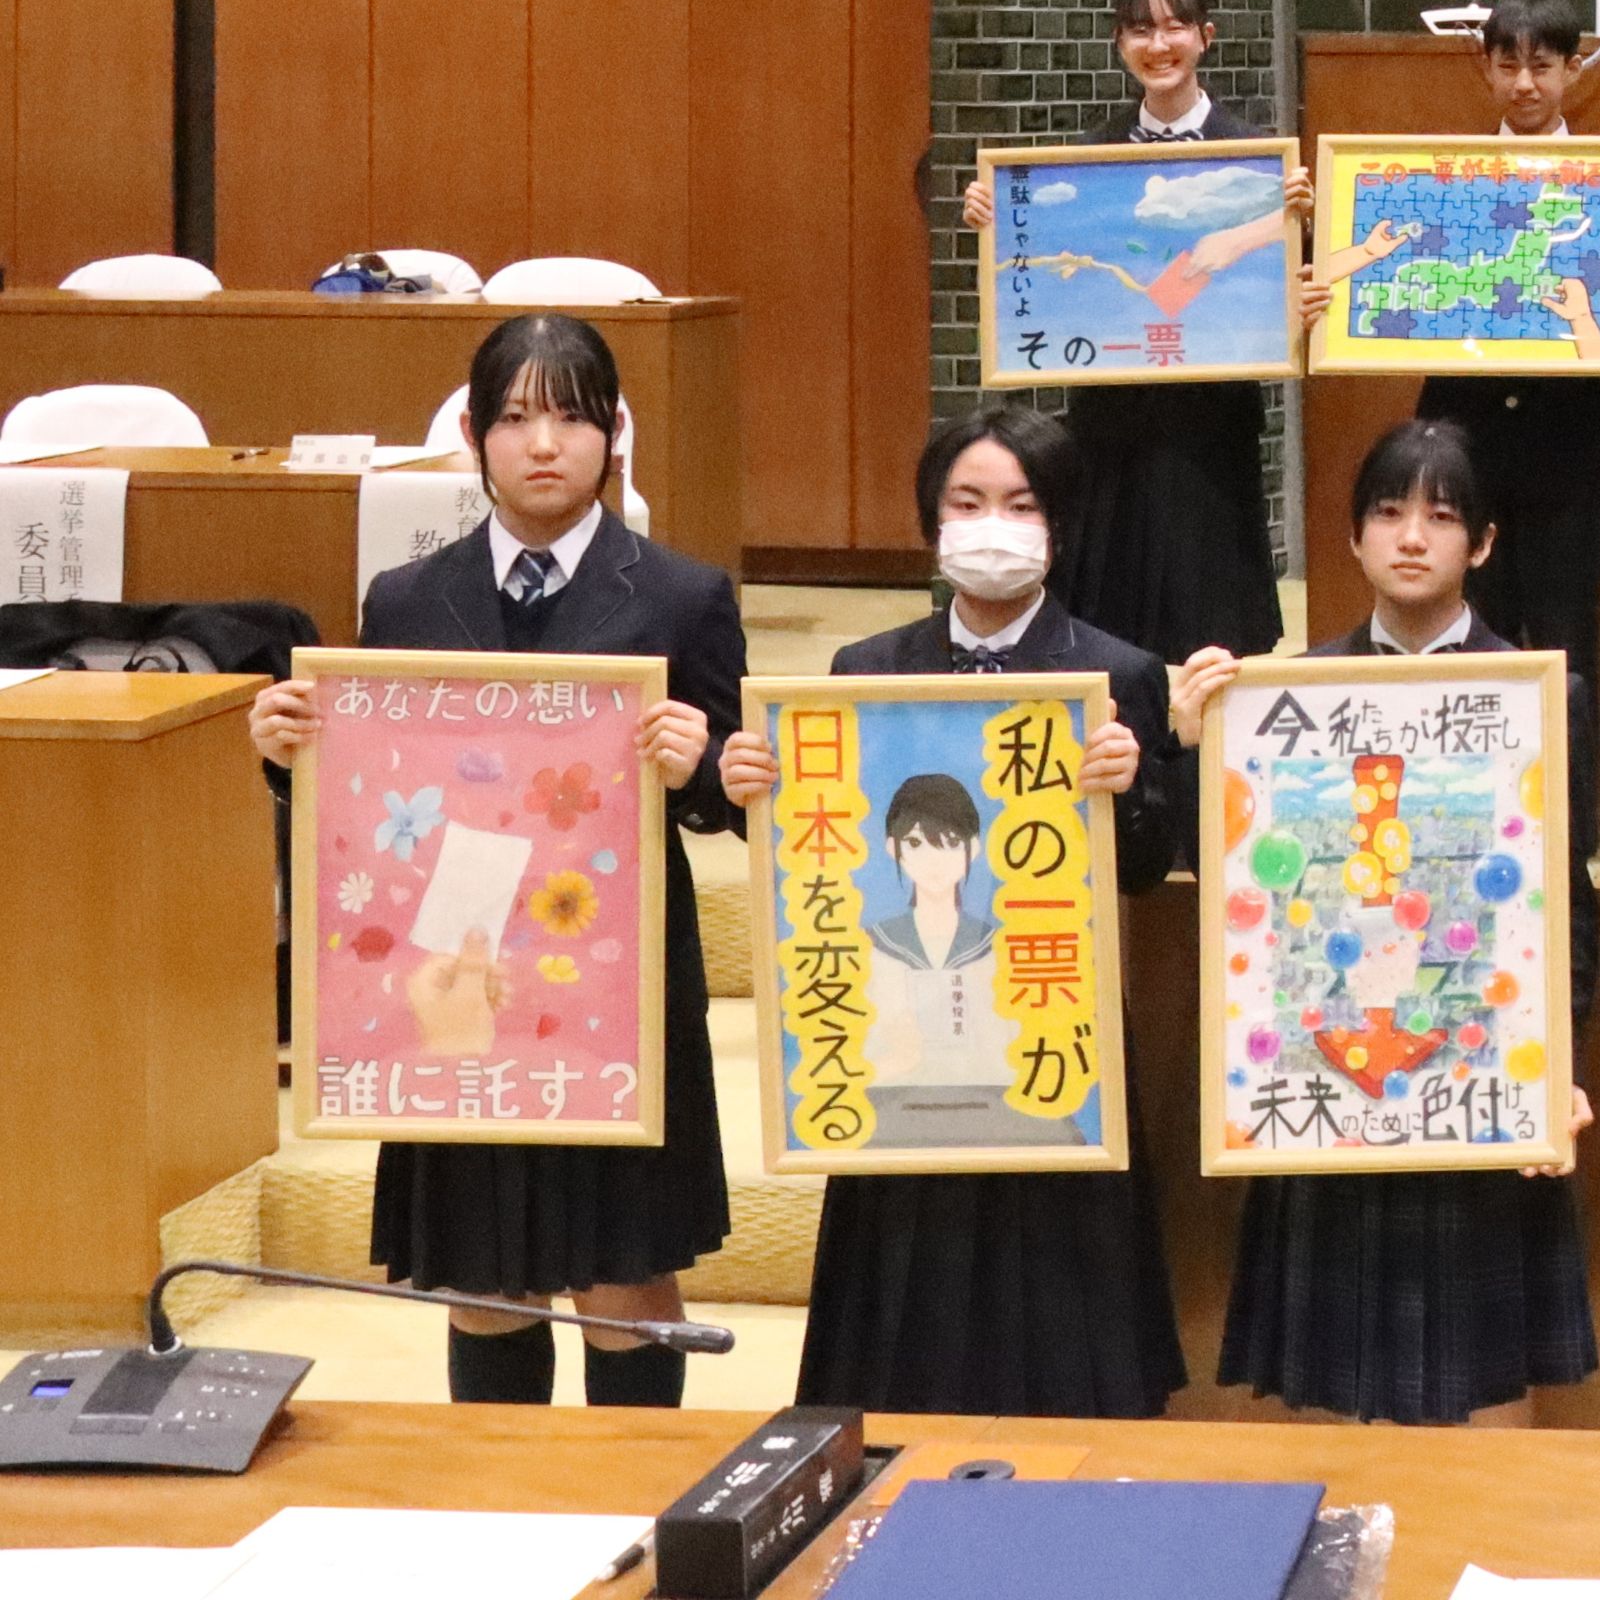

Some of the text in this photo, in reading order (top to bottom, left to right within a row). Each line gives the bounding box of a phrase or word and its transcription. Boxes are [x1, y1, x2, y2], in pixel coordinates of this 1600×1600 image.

[1017, 322, 1186, 370] その一票
[60, 480, 85, 601] 選挙管理
[334, 677, 625, 726] あなたの想い
[790, 708, 867, 1143] 日本を変える
[997, 714, 1093, 1104] 私の一票が
[1243, 1072, 1537, 1149] 未来のために色付ける
